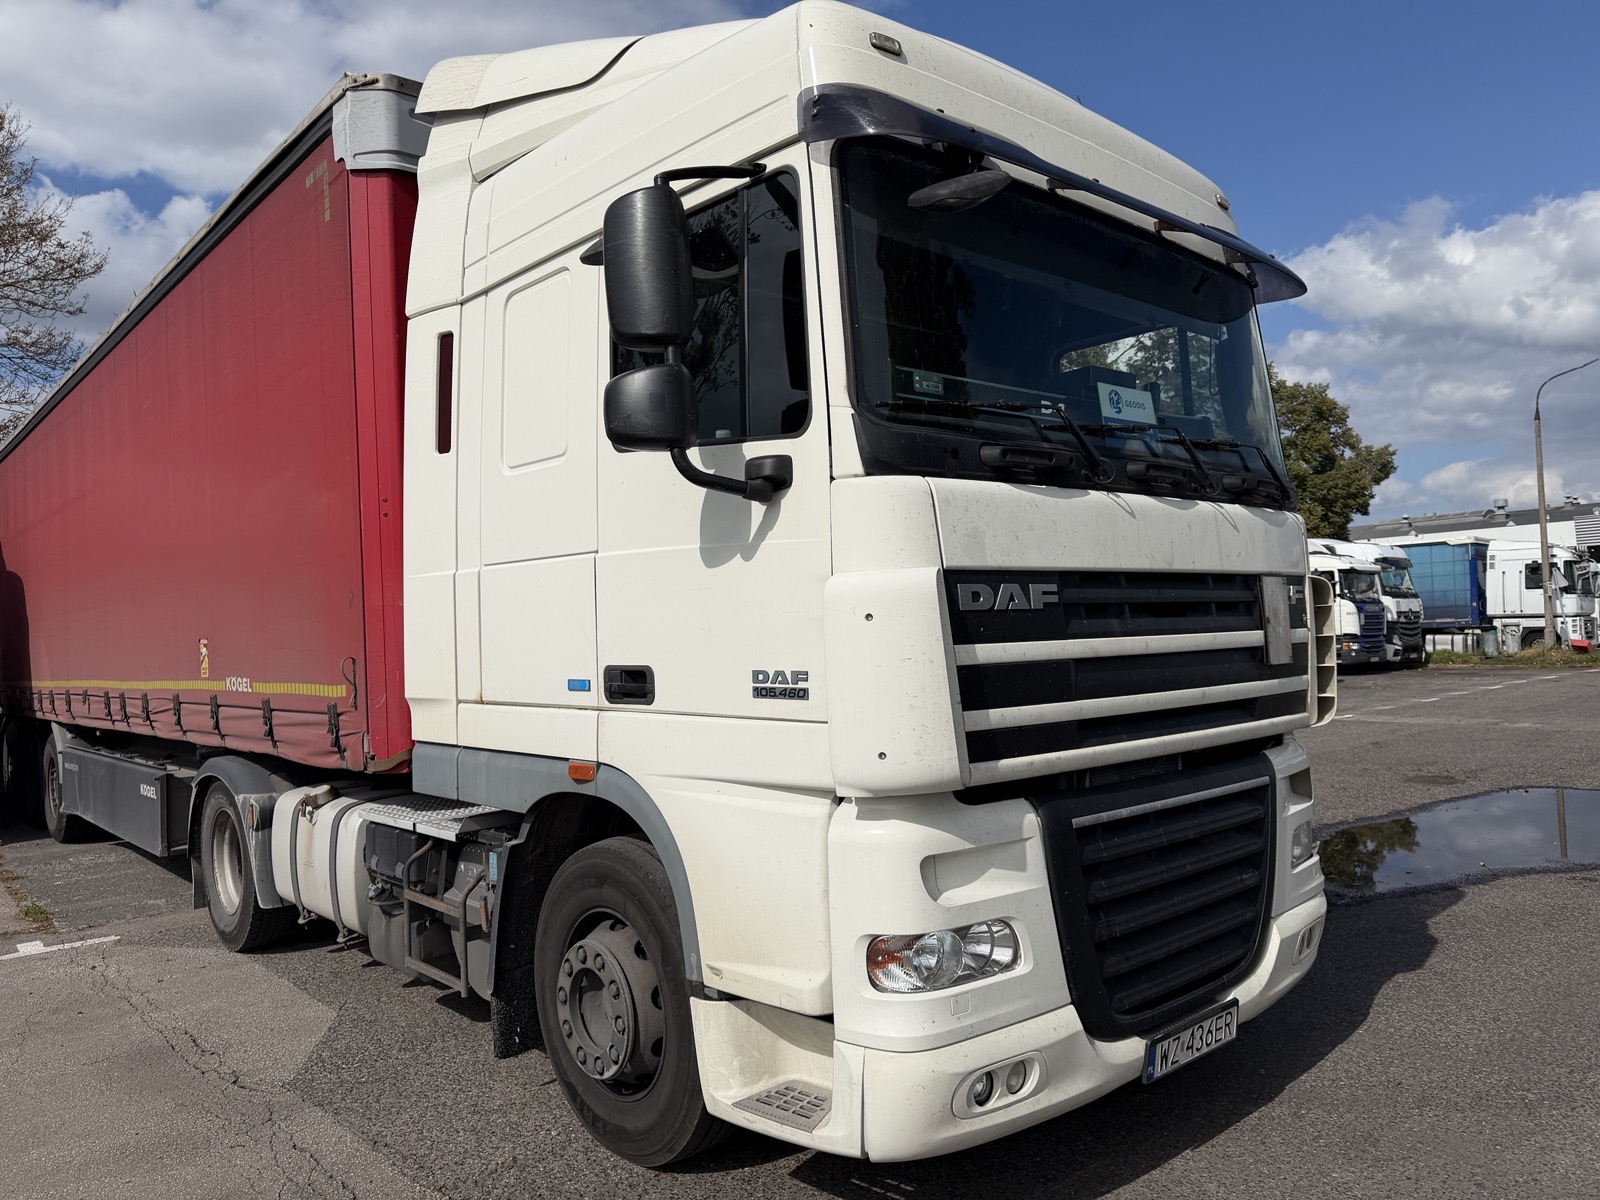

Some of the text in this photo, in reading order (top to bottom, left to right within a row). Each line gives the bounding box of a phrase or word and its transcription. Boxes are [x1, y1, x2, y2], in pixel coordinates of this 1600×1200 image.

[1125, 400, 1146, 410] GEODIS
[957, 582, 1059, 611] DAF
[225, 676, 252, 692] KÖGEL
[752, 670, 808, 685] DAF
[753, 687, 806, 698] 105.460
[1159, 1011, 1233, 1072] WZ 436ER
